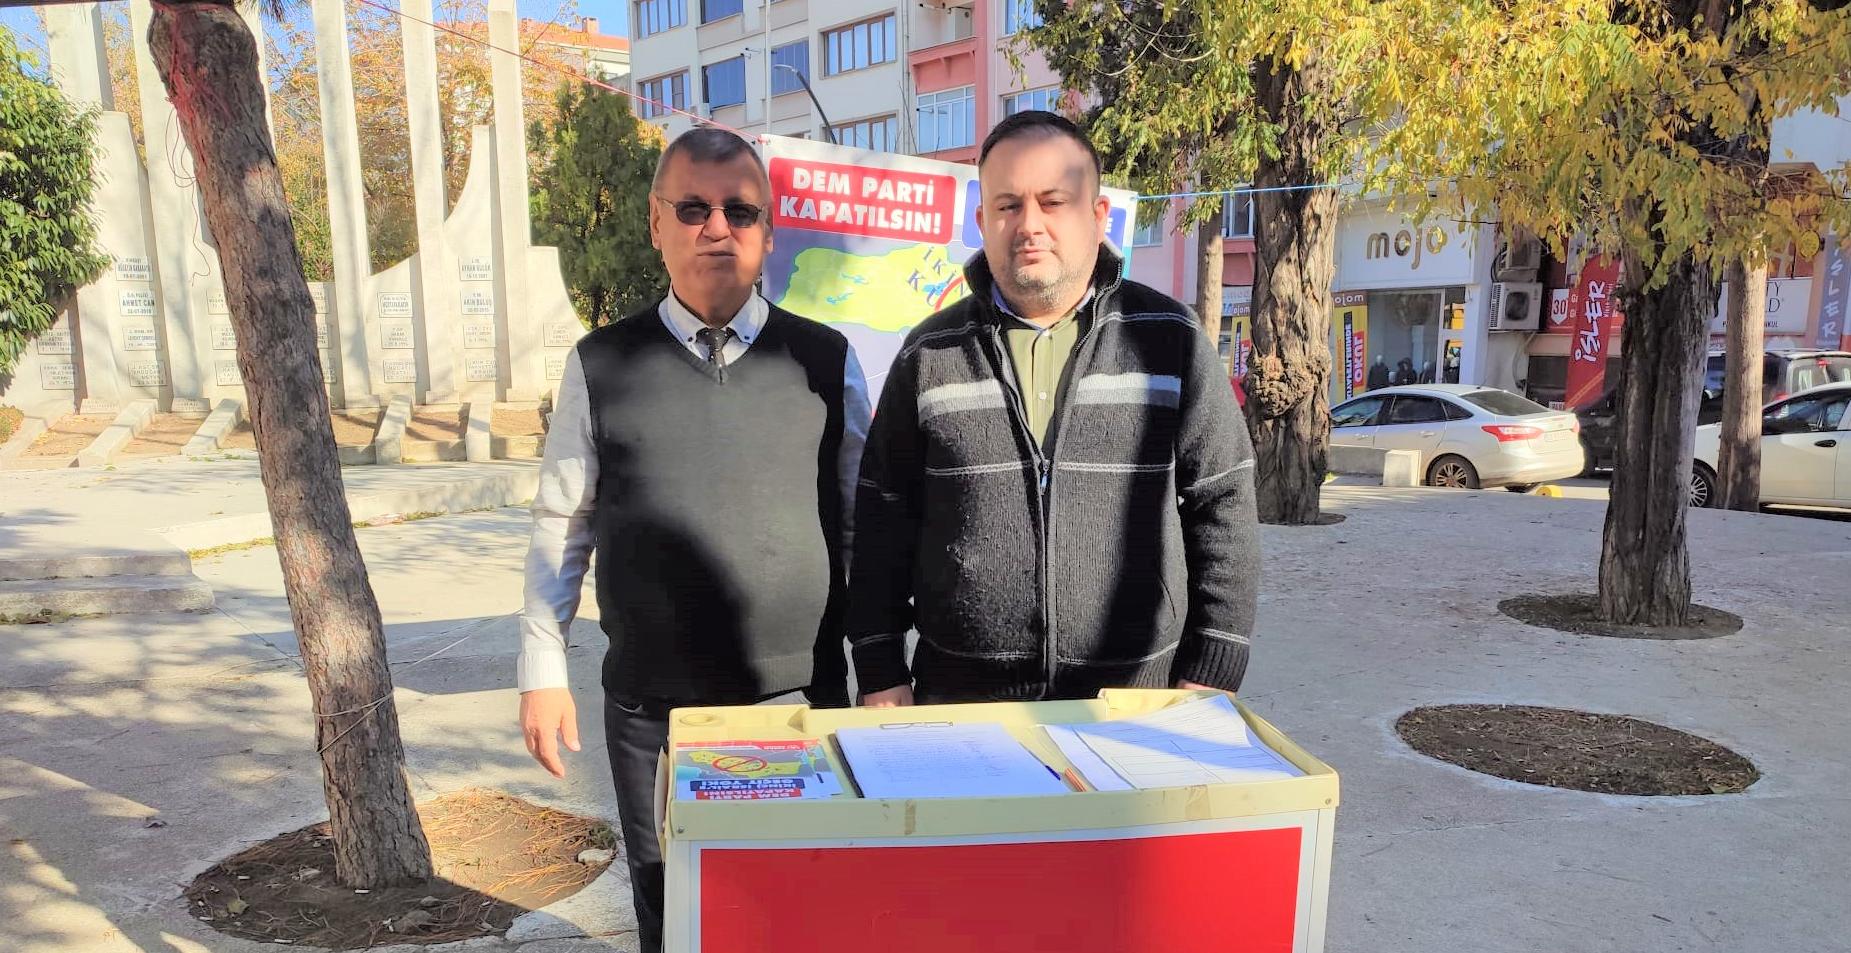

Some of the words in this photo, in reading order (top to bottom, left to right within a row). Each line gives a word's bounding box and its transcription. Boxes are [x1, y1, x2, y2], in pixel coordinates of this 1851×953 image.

[792, 167, 851, 196] DEM
[862, 179, 935, 206] PARTİ
[779, 195, 942, 235] KAPATILSIN!
[1366, 225, 1447, 270] mojo
[1553, 299, 1567, 315] 30
